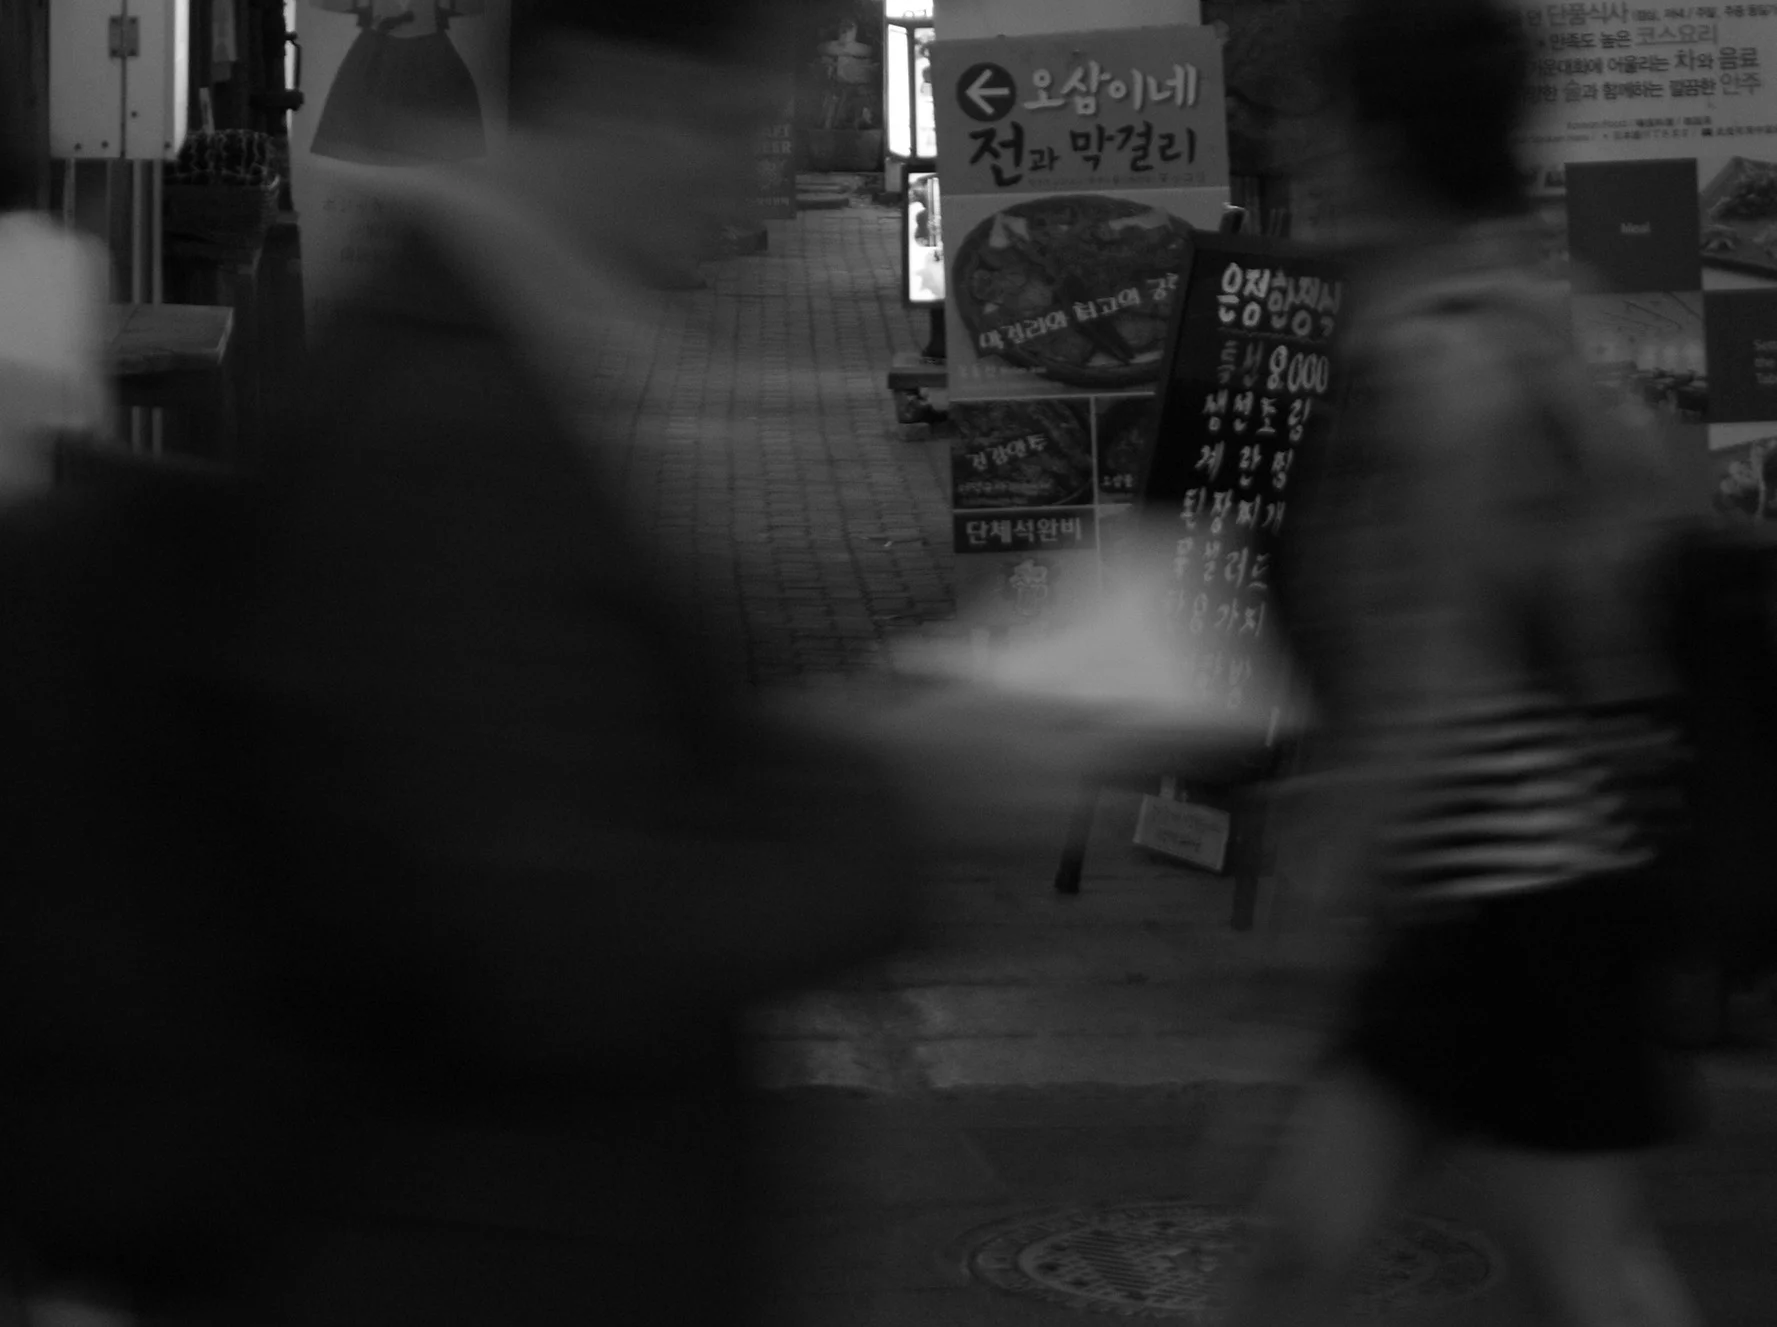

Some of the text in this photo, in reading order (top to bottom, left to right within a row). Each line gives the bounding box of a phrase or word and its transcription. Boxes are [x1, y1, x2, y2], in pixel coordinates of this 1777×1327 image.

[1637, 23, 1718, 47] 코스요리
[1607, 55, 1670, 75] 어울리는
[1674, 48, 1714, 72] 차와
[1719, 46, 1761, 71] 음료
[1023, 60, 1198, 115] 오삼이네
[1719, 73, 1763, 96] 안주
[1069, 121, 1197, 172] 막걸리
